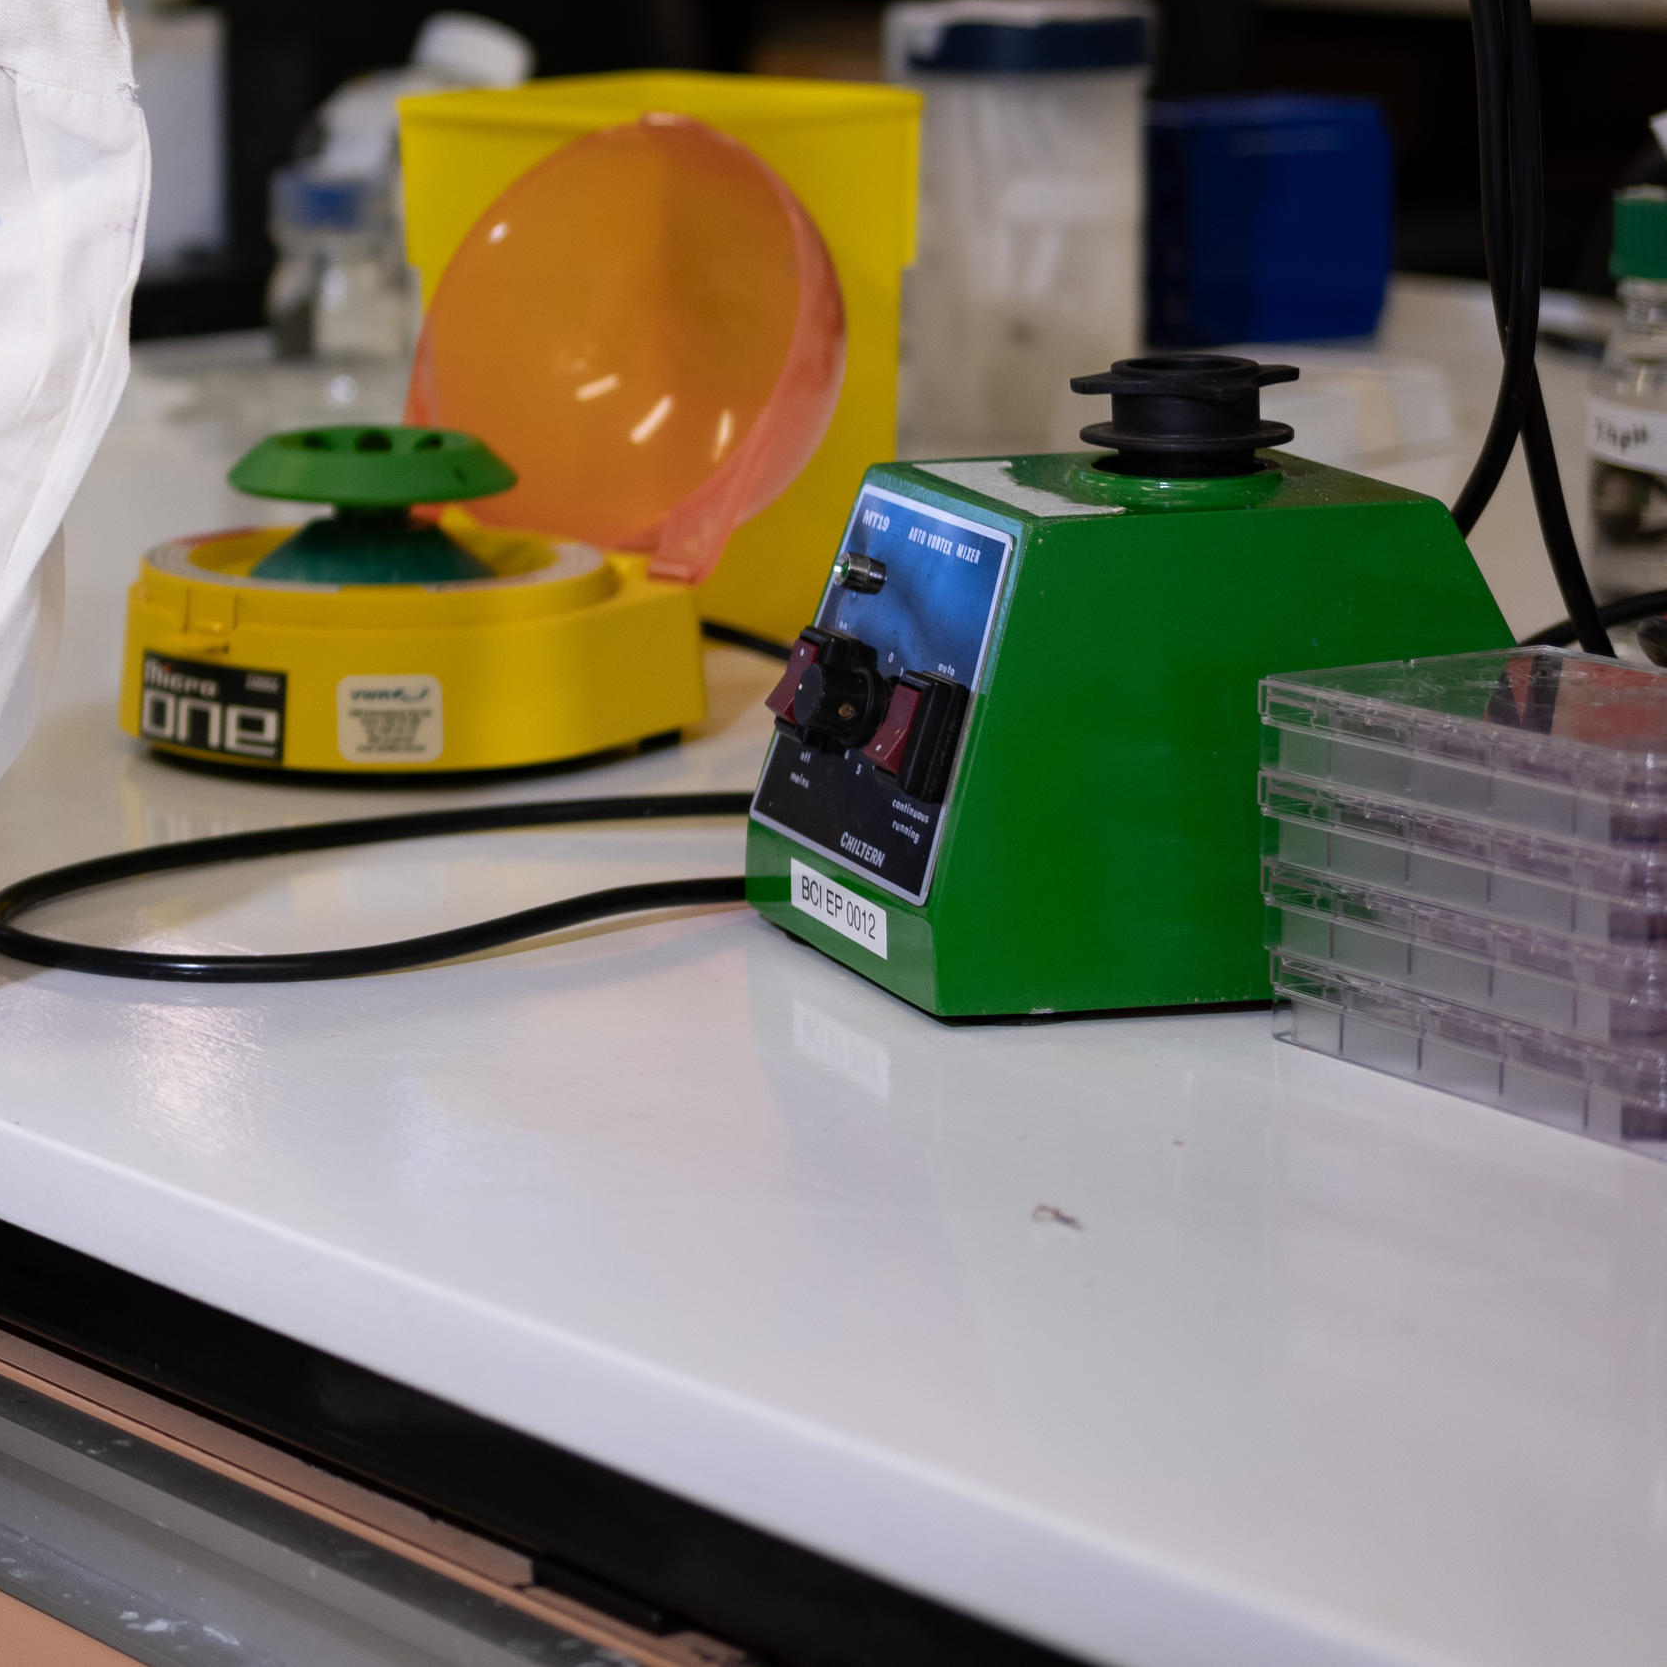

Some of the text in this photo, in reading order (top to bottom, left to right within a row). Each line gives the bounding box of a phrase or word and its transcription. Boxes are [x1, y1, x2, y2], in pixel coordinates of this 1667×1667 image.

[907, 526, 981, 565] AUTO VORTEX MIXER
[145, 657, 218, 698] Micro
[937, 662, 956, 677] auto
[141, 687, 279, 759] one
[800, 751, 812, 764] off
[789, 771, 810, 789] mains
[891, 798, 930, 824] continuous
[891, 820, 921, 845] running
[840, 830, 886, 869] CHILTERN
[801, 875, 876, 941] BCI EP 0012
